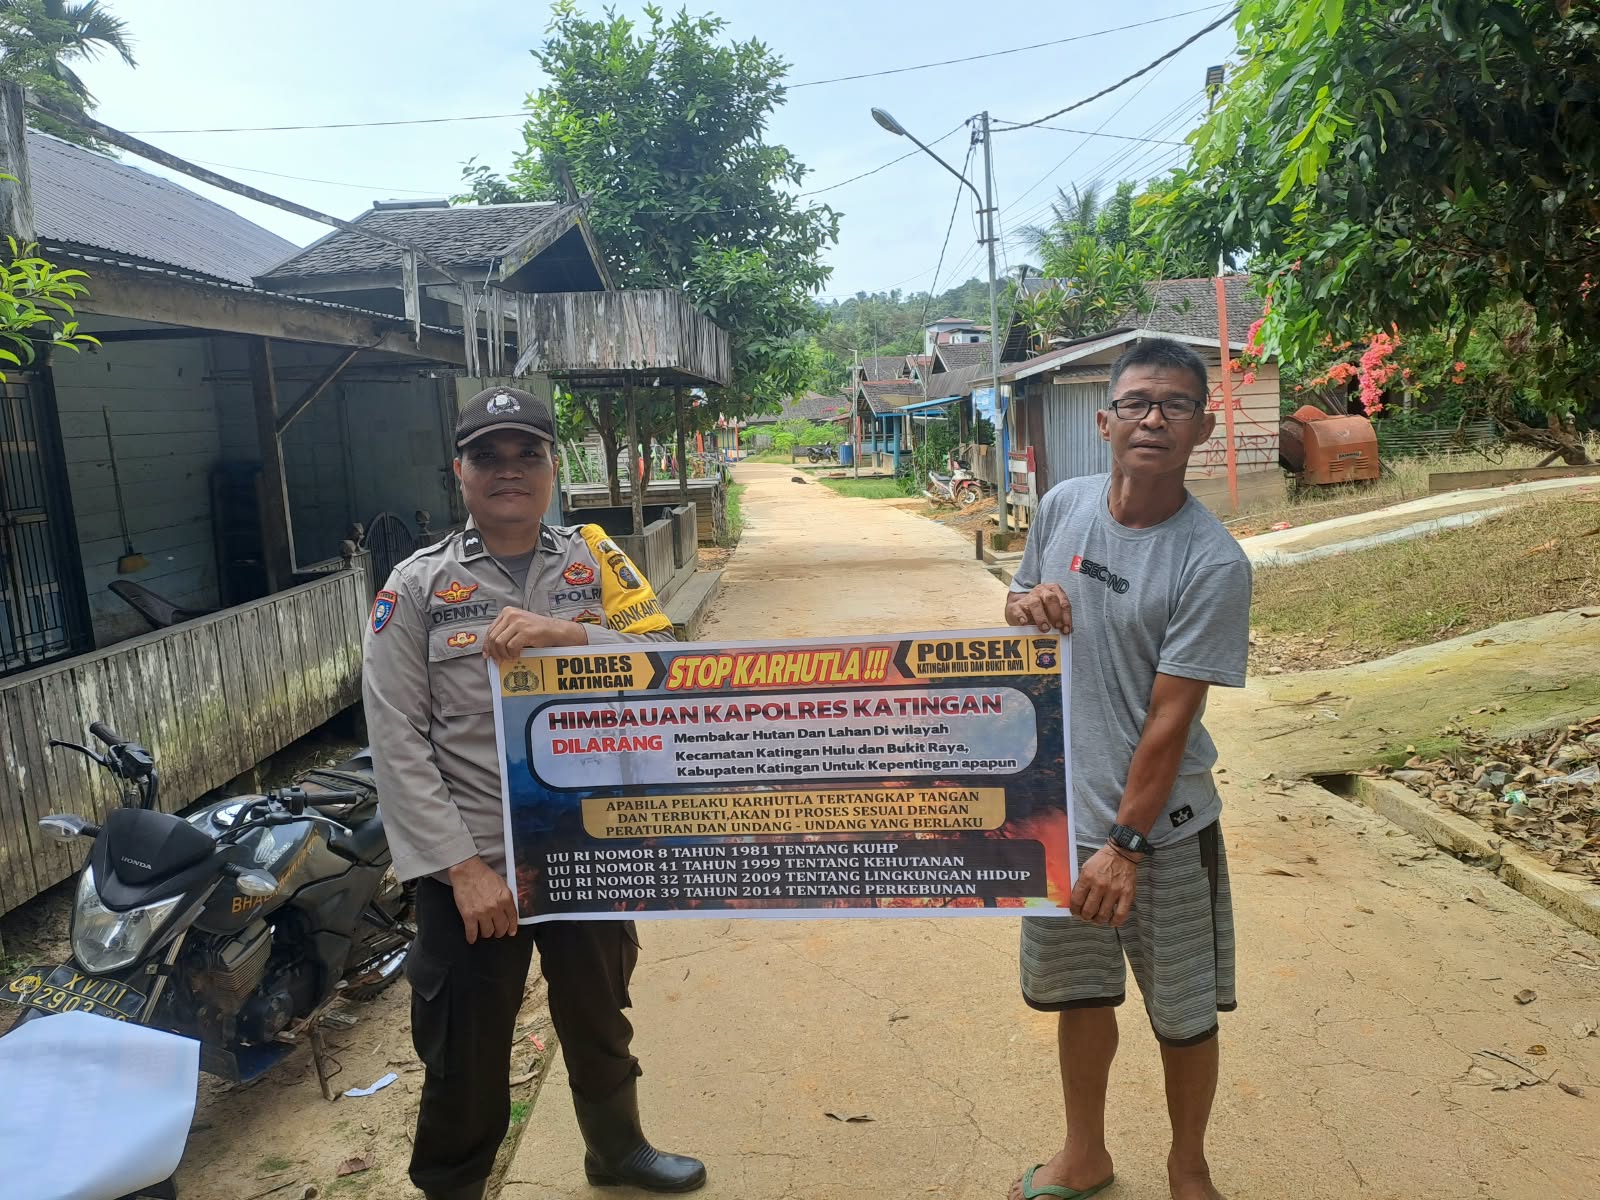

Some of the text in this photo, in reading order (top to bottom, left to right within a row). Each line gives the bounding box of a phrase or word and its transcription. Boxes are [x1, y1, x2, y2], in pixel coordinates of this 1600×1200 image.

[432, 603, 489, 624] DENNY
[917, 639, 1022, 662] POLSEK
[556, 655, 632, 675] POLRES
[917, 659, 1024, 674] KATINGAN HULU DAN BUKIT RAYA
[558, 674, 634, 690] KATINGAN
[548, 694, 1002, 730] HIMBAUAN KAPOLRES KATINGAN
[674, 724, 949, 744] Membakar Hutan Dan Lahan Di wilayah
[552, 735, 663, 754] DILARANG
[675, 742, 970, 761] Kecamatan Katingan Hulu dan Bukit Raya,
[677, 758, 1017, 778] Kabupaten Katingan Untuk Kepentingan apapun
[606, 791, 980, 812] APABILA PELAKU KARHUTLA TERTANGKAP TANGAN
[618, 812, 648, 823] DAN
[775, 808, 790, 819] DI
[795, 806, 849, 818] PROSES
[853, 805, 903, 817] SESUAI
[907, 805, 969, 815] DENGAN
[606, 823, 695, 836] PERATURAN
[697, 823, 729, 833] DAN
[731, 821, 792, 833] UNDANG
[805, 819, 867, 831] UNDANG
[870, 818, 909, 829] YANG
[913, 817, 983, 828] BERLAKU
[121, 855, 152, 870] HONDA
[546, 843, 899, 864] UU RI NOMOR 8 TAHUN 1981 TENTANG KUHP
[547, 856, 965, 876] UU RI NOMOR 41 TAHUN 1999 TENTANG KEHUTANAN
[548, 870, 1031, 889] UU RI NOMOR 32 TAHUN 2009 TENTANG LINGKUNGAN HIDUP
[549, 884, 976, 902] UU RI NOMOR 39 TAHUN 2014 TENTANG PERKEBUNAN
